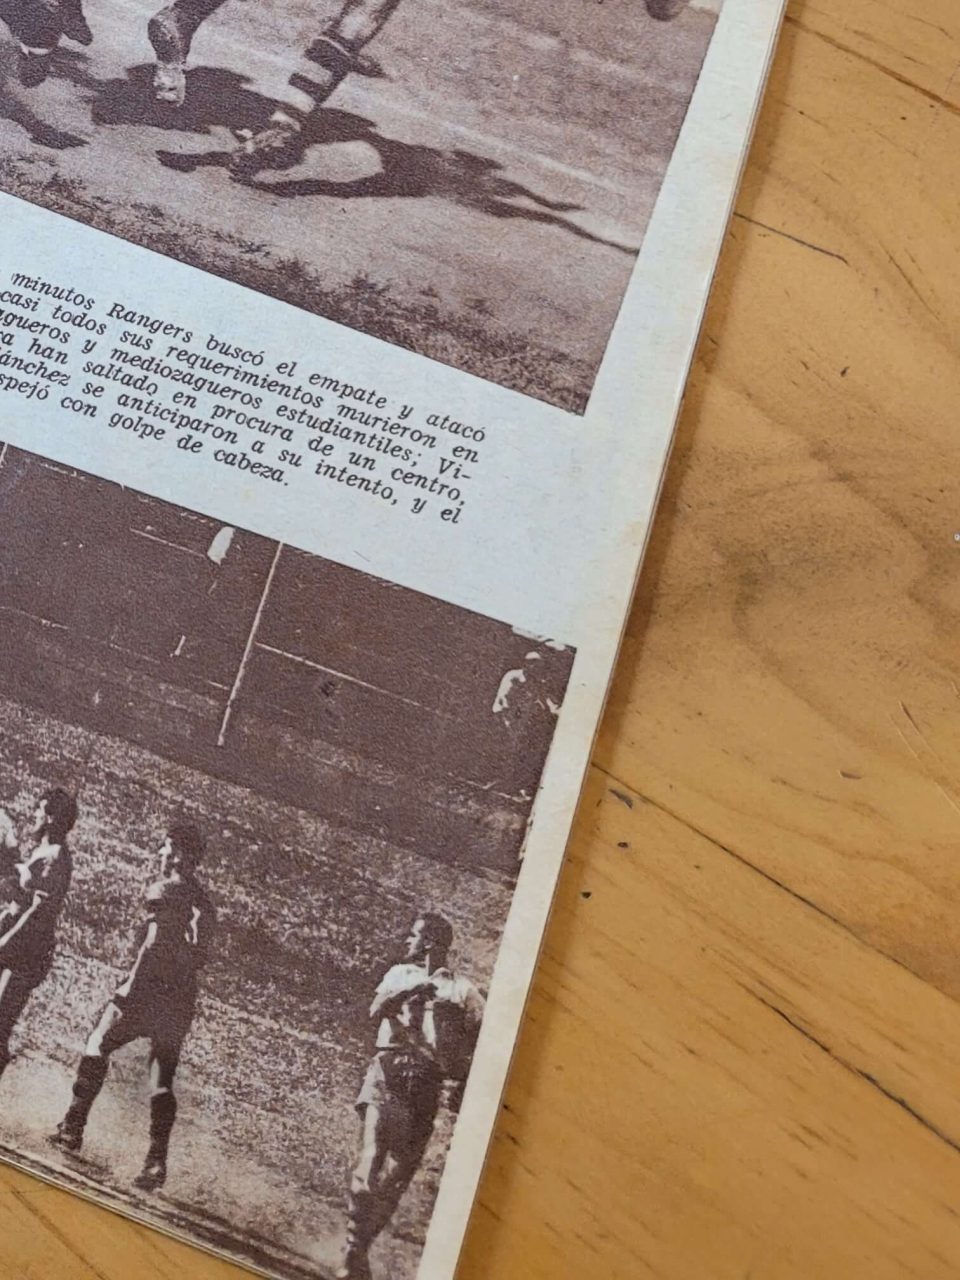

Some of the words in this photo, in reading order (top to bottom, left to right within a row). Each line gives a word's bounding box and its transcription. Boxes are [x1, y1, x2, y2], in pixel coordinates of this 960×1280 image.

[10, 272, 96, 310] minutos
[105, 302, 193, 343] Rangers
[205, 333, 265, 368] buscó
[276, 361, 298, 377] el
[308, 373, 387, 409] empate
[397, 404, 414, 420] y
[425, 413, 486, 442] atacó
[27, 337, 68, 365] han
[82, 361, 158, 396] saltado
[172, 391, 197, 409] en
[210, 404, 294, 442] procura
[307, 435, 334, 456] de
[348, 451, 376, 471] un
[390, 467, 465, 506] centro,
[51, 304, 107, 335] todos
[119, 330, 153, 351] sus
[166, 345, 324, 408] requerimientos
[336, 404, 437, 449] murieron
[451, 445, 479, 463] en
[80, 339, 97, 354] y
[110, 347, 263, 409] mediozagueros
[275, 404, 422, 467] estudiantiles;
[438, 456, 471, 479] Vi-
[59, 396, 97, 418] con
[107, 412, 166, 441] golpe
[176, 434, 203, 453] de
[213, 449, 289, 486] cabeza.
[81, 382, 105, 398] se
[116, 393, 238, 444] anticiparon
[250, 440, 265, 454] a
[277, 449, 302, 467] su
[314, 458, 398, 506] intento,
[410, 497, 427, 514] y
[439, 507, 461, 524] el
